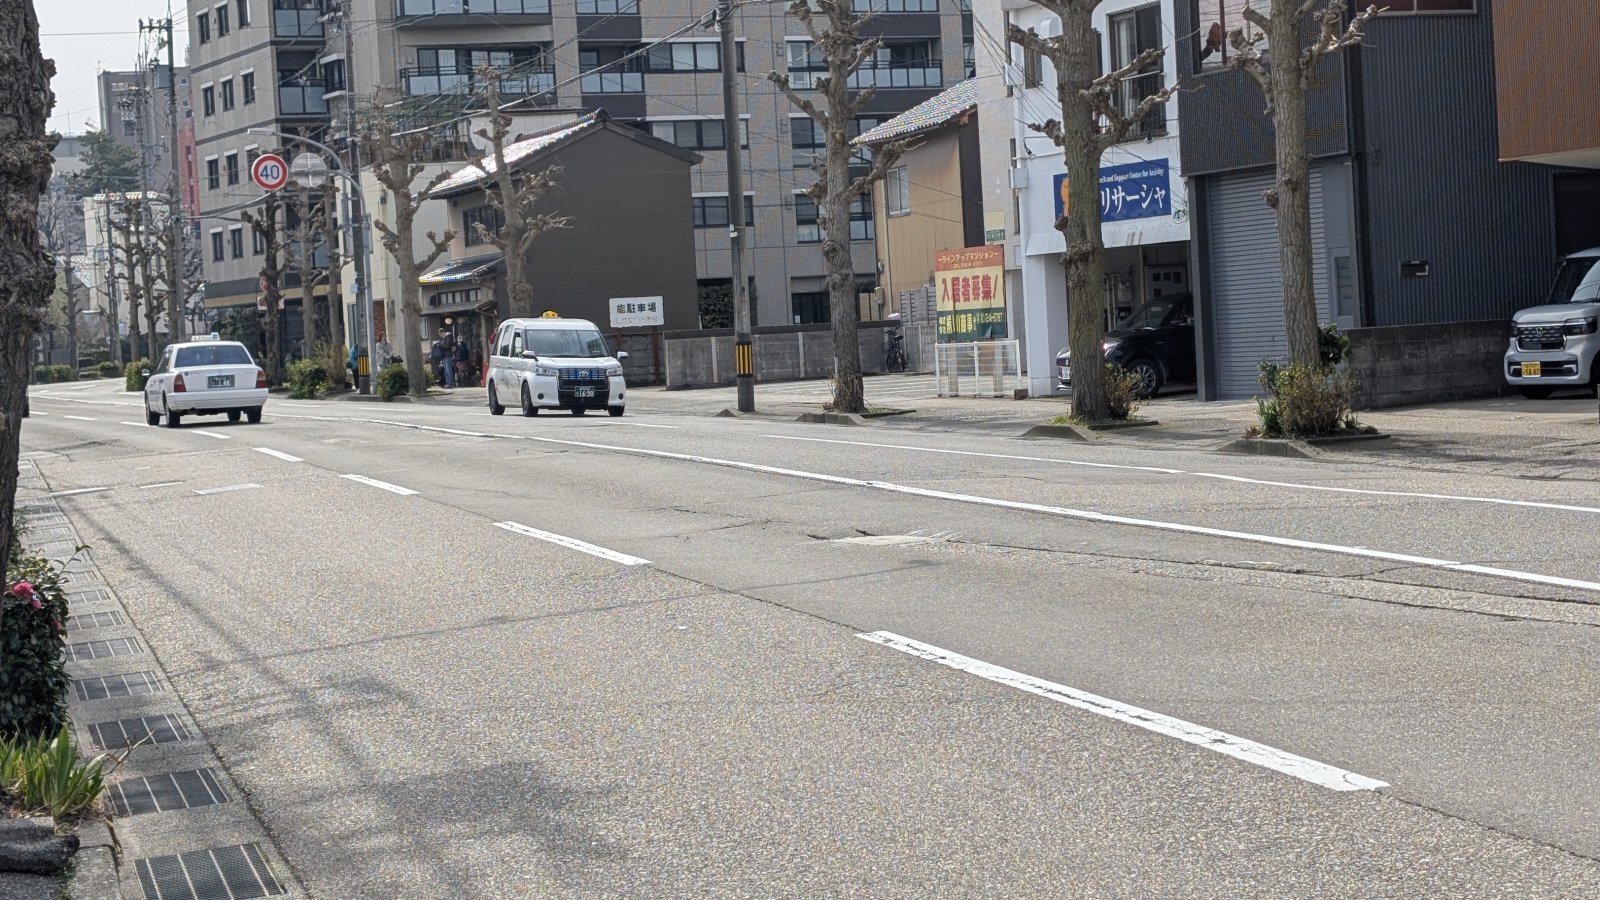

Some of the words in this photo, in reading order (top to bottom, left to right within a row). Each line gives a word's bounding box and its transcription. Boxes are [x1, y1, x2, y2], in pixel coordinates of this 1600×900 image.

[260, 164, 280, 180] 40
[1100, 184, 1166, 215] リサーシャ
[941, 274, 998, 303] 入居者募集!
[616, 302, 657, 314] 能駐車場
